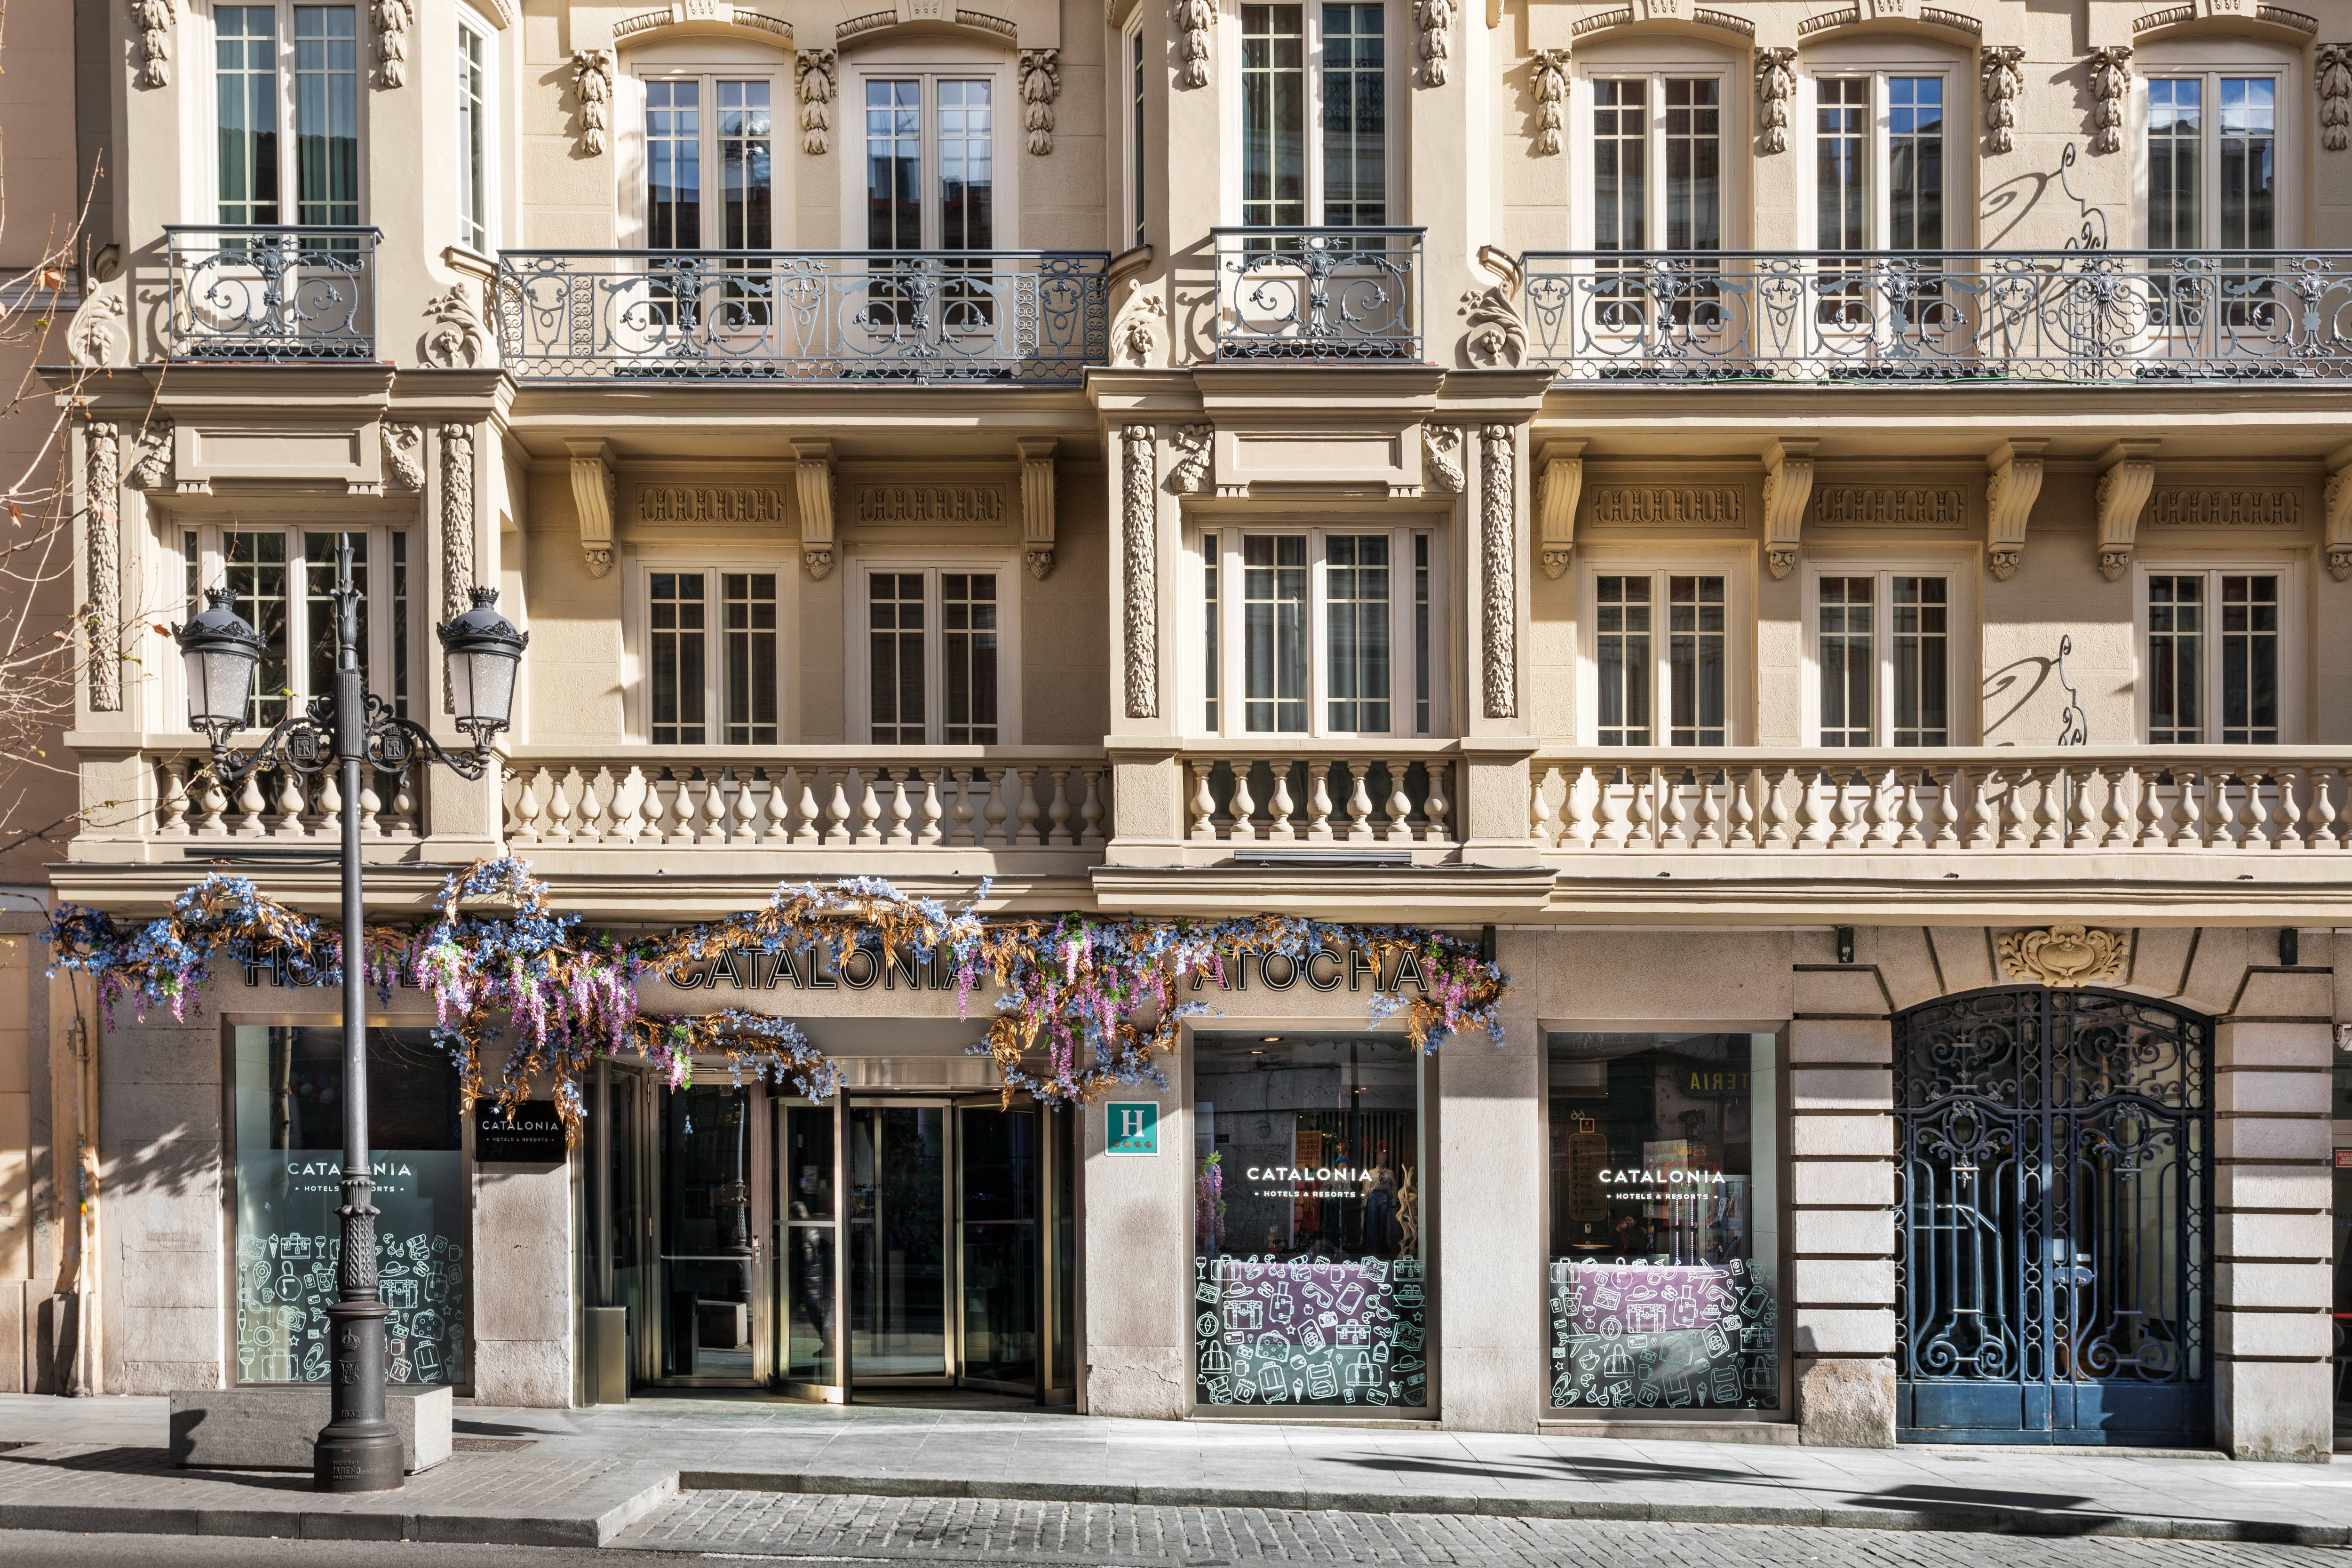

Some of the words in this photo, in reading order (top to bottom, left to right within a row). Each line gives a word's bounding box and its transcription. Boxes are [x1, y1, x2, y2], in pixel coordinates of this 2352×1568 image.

[482, 1121, 559, 1130] CATALONIA
[1121, 1110, 1144, 1137] H
[287, 1162, 412, 1176] CATANIA
[1247, 1167, 1372, 1181] CATALONIA
[1599, 1170, 1725, 1183] CATALONIA
[342, 1409, 360, 1418] 1832
